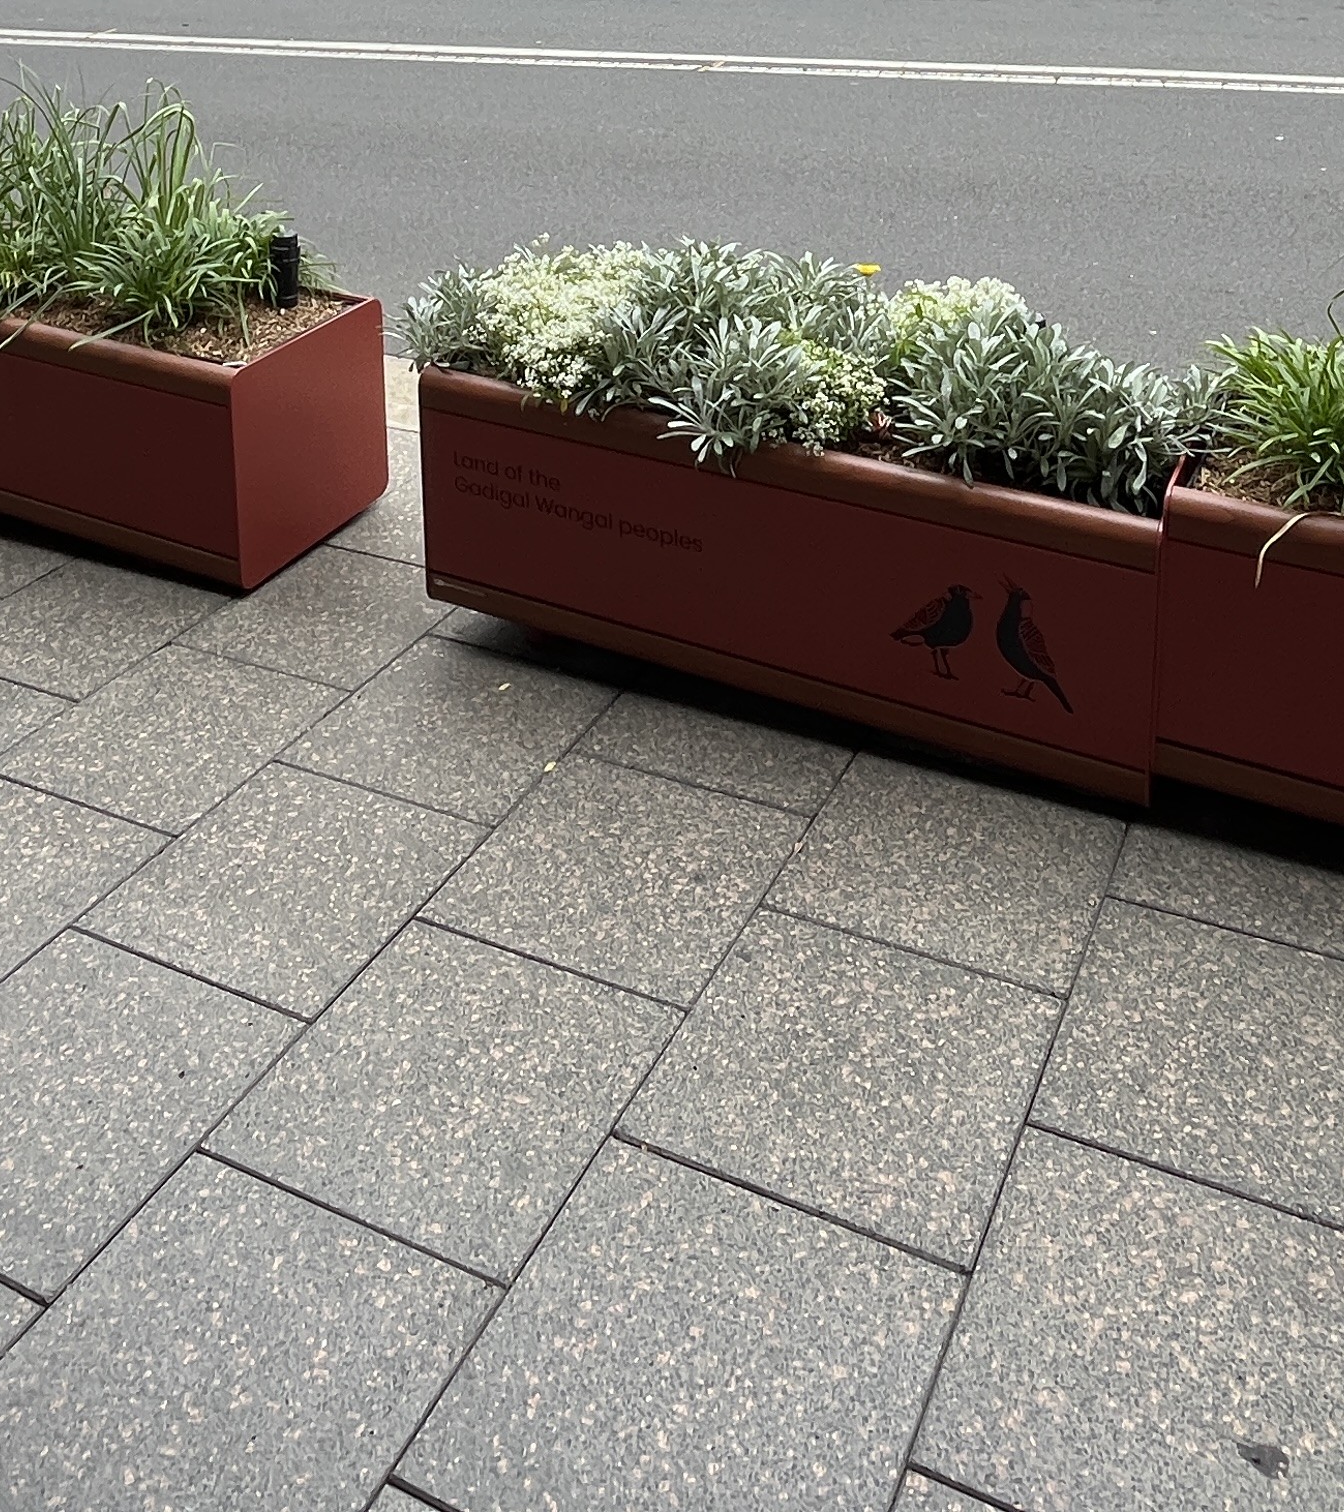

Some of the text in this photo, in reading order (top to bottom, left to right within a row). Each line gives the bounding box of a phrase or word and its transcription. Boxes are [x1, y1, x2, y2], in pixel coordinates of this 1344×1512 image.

[453, 451, 561, 491] Land of the
[454, 476, 703, 552] Gadigal Wangal peoples
